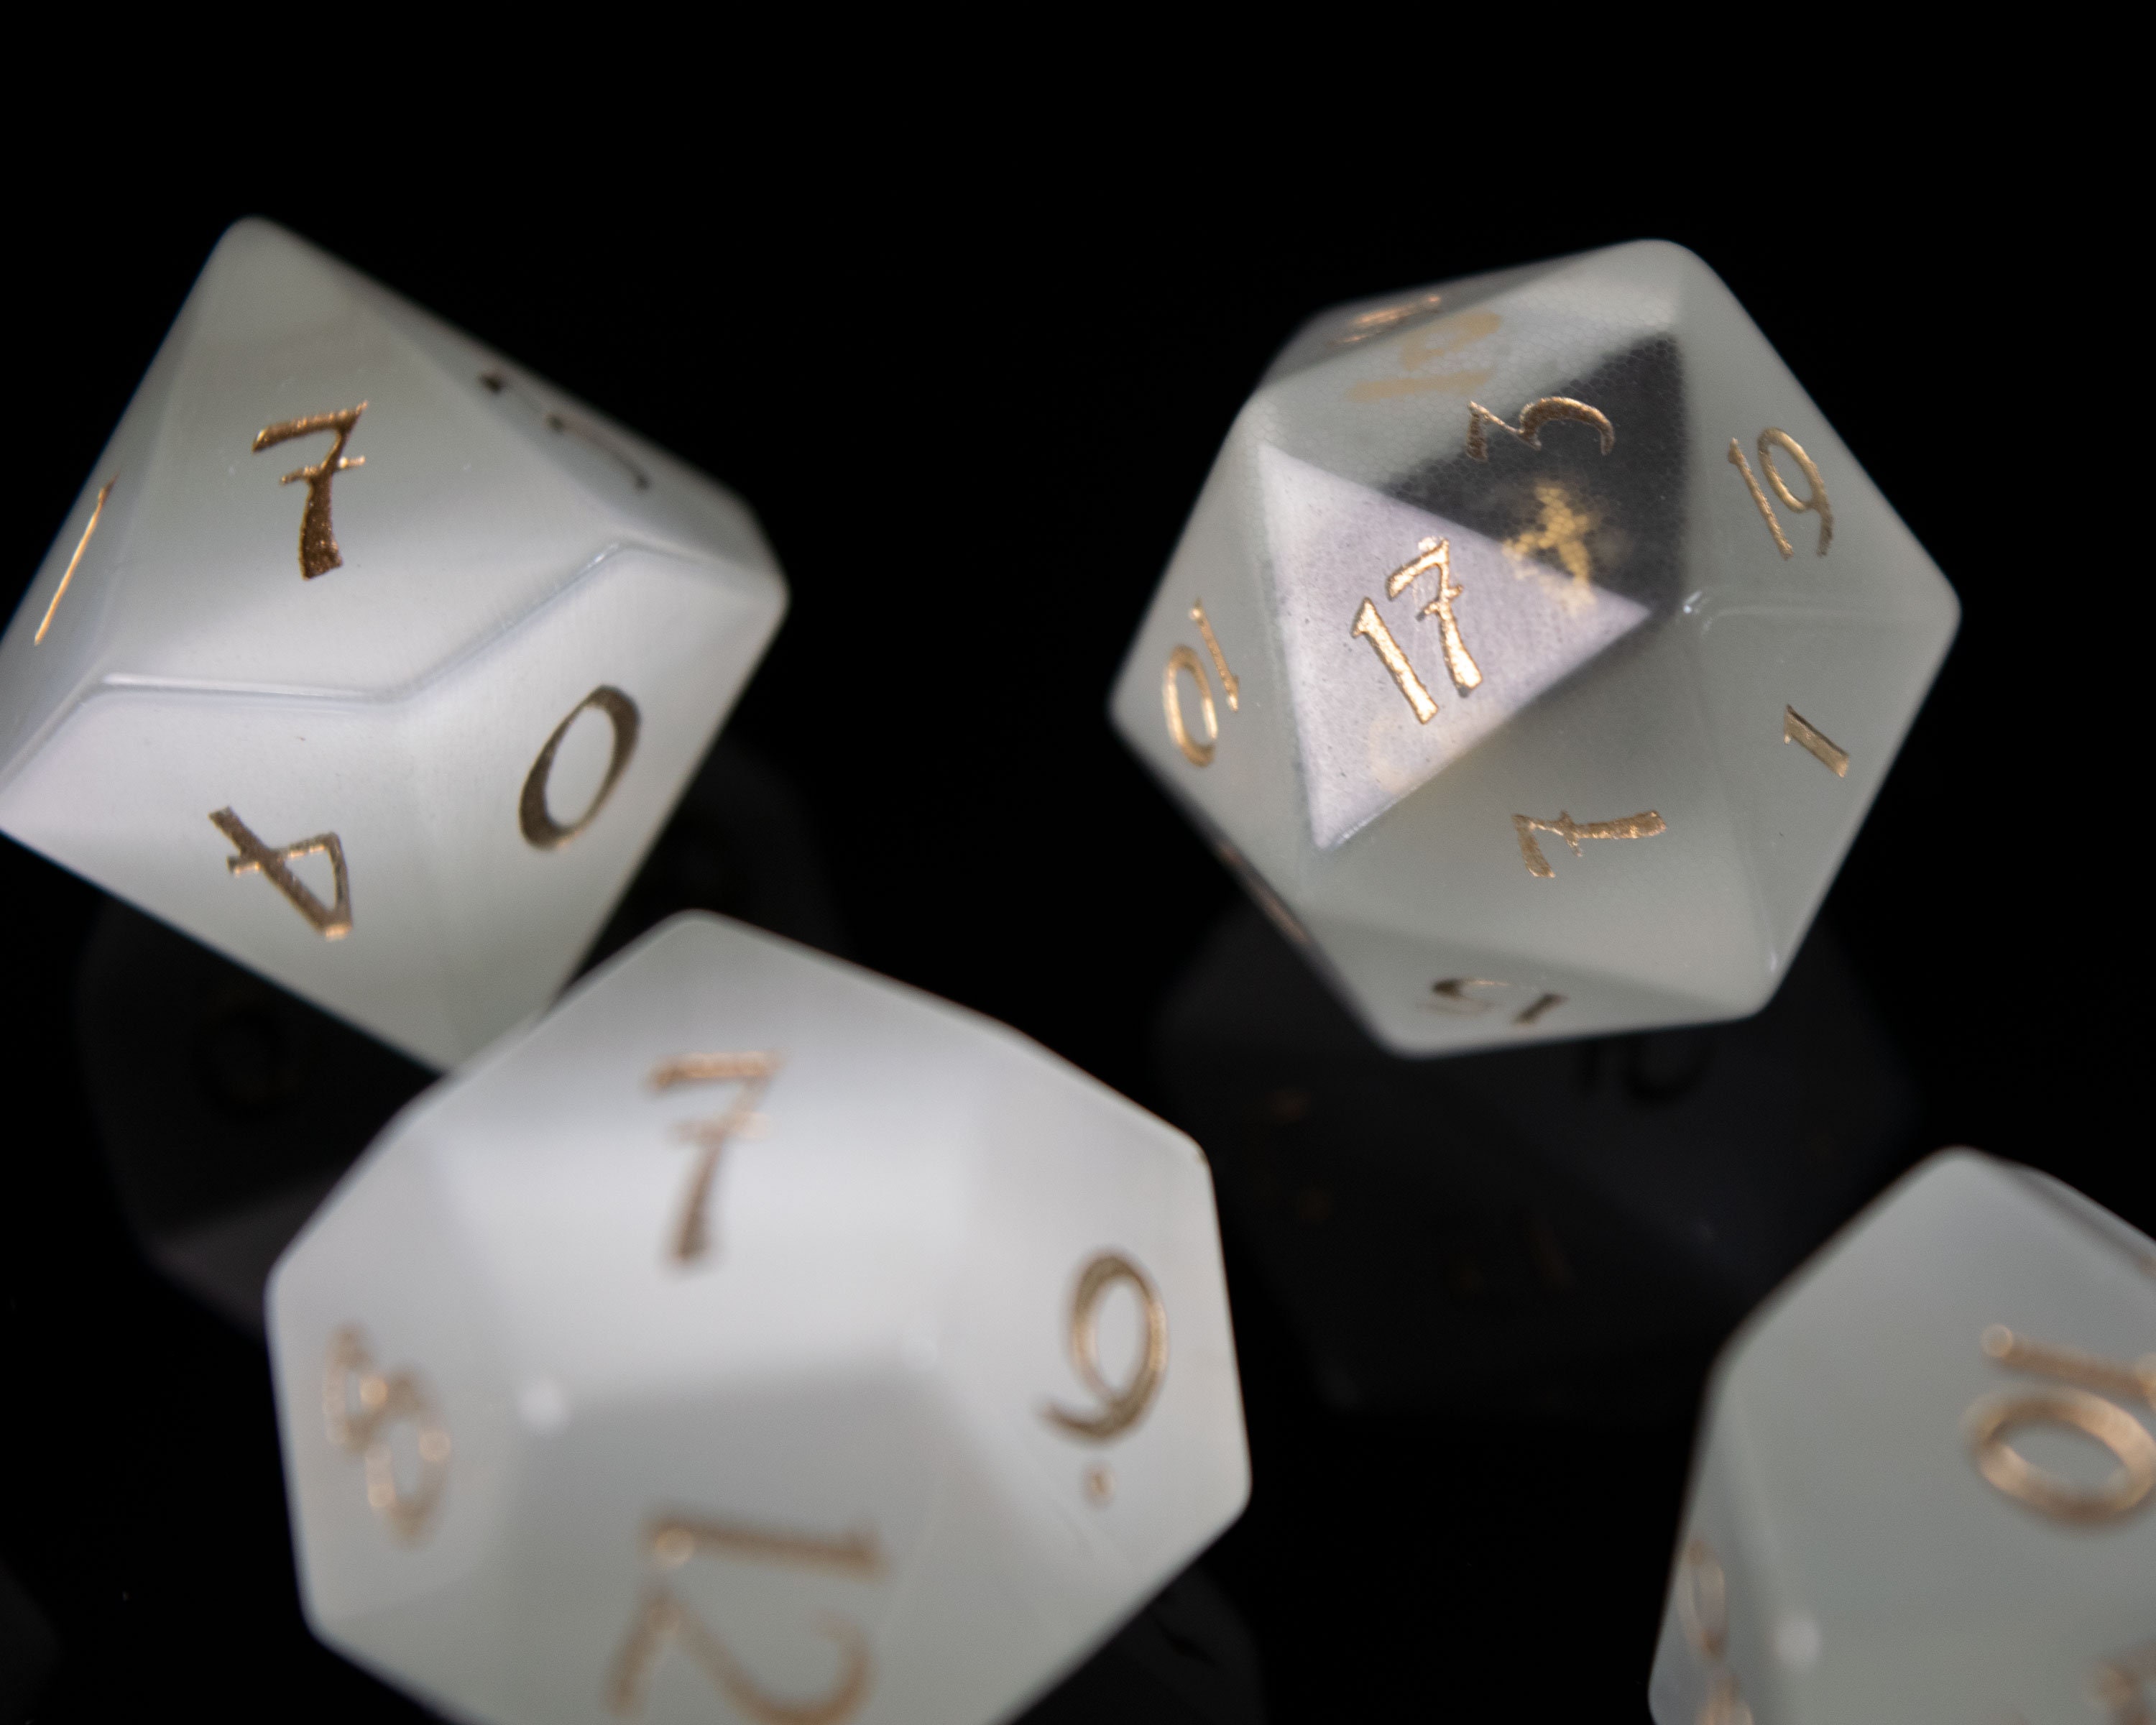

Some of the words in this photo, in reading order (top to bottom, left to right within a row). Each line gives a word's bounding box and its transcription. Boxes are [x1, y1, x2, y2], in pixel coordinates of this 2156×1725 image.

[252, 400, 367, 580] 7
[1466, 396, 1616, 462] 3
[1728, 428, 1834, 560] 19
[1162, 598, 1240, 768] 10
[1350, 535, 1483, 724] 17
[520, 685, 642, 850] 0
[1782, 705, 1849, 777] 1
[209, 806, 352, 940] 4
[1511, 810, 1667, 878] 7
[645, 1048, 787, 1271] 7
[323, 1324, 451, 1544] 8
[604, 1502, 890, 1725] 12
